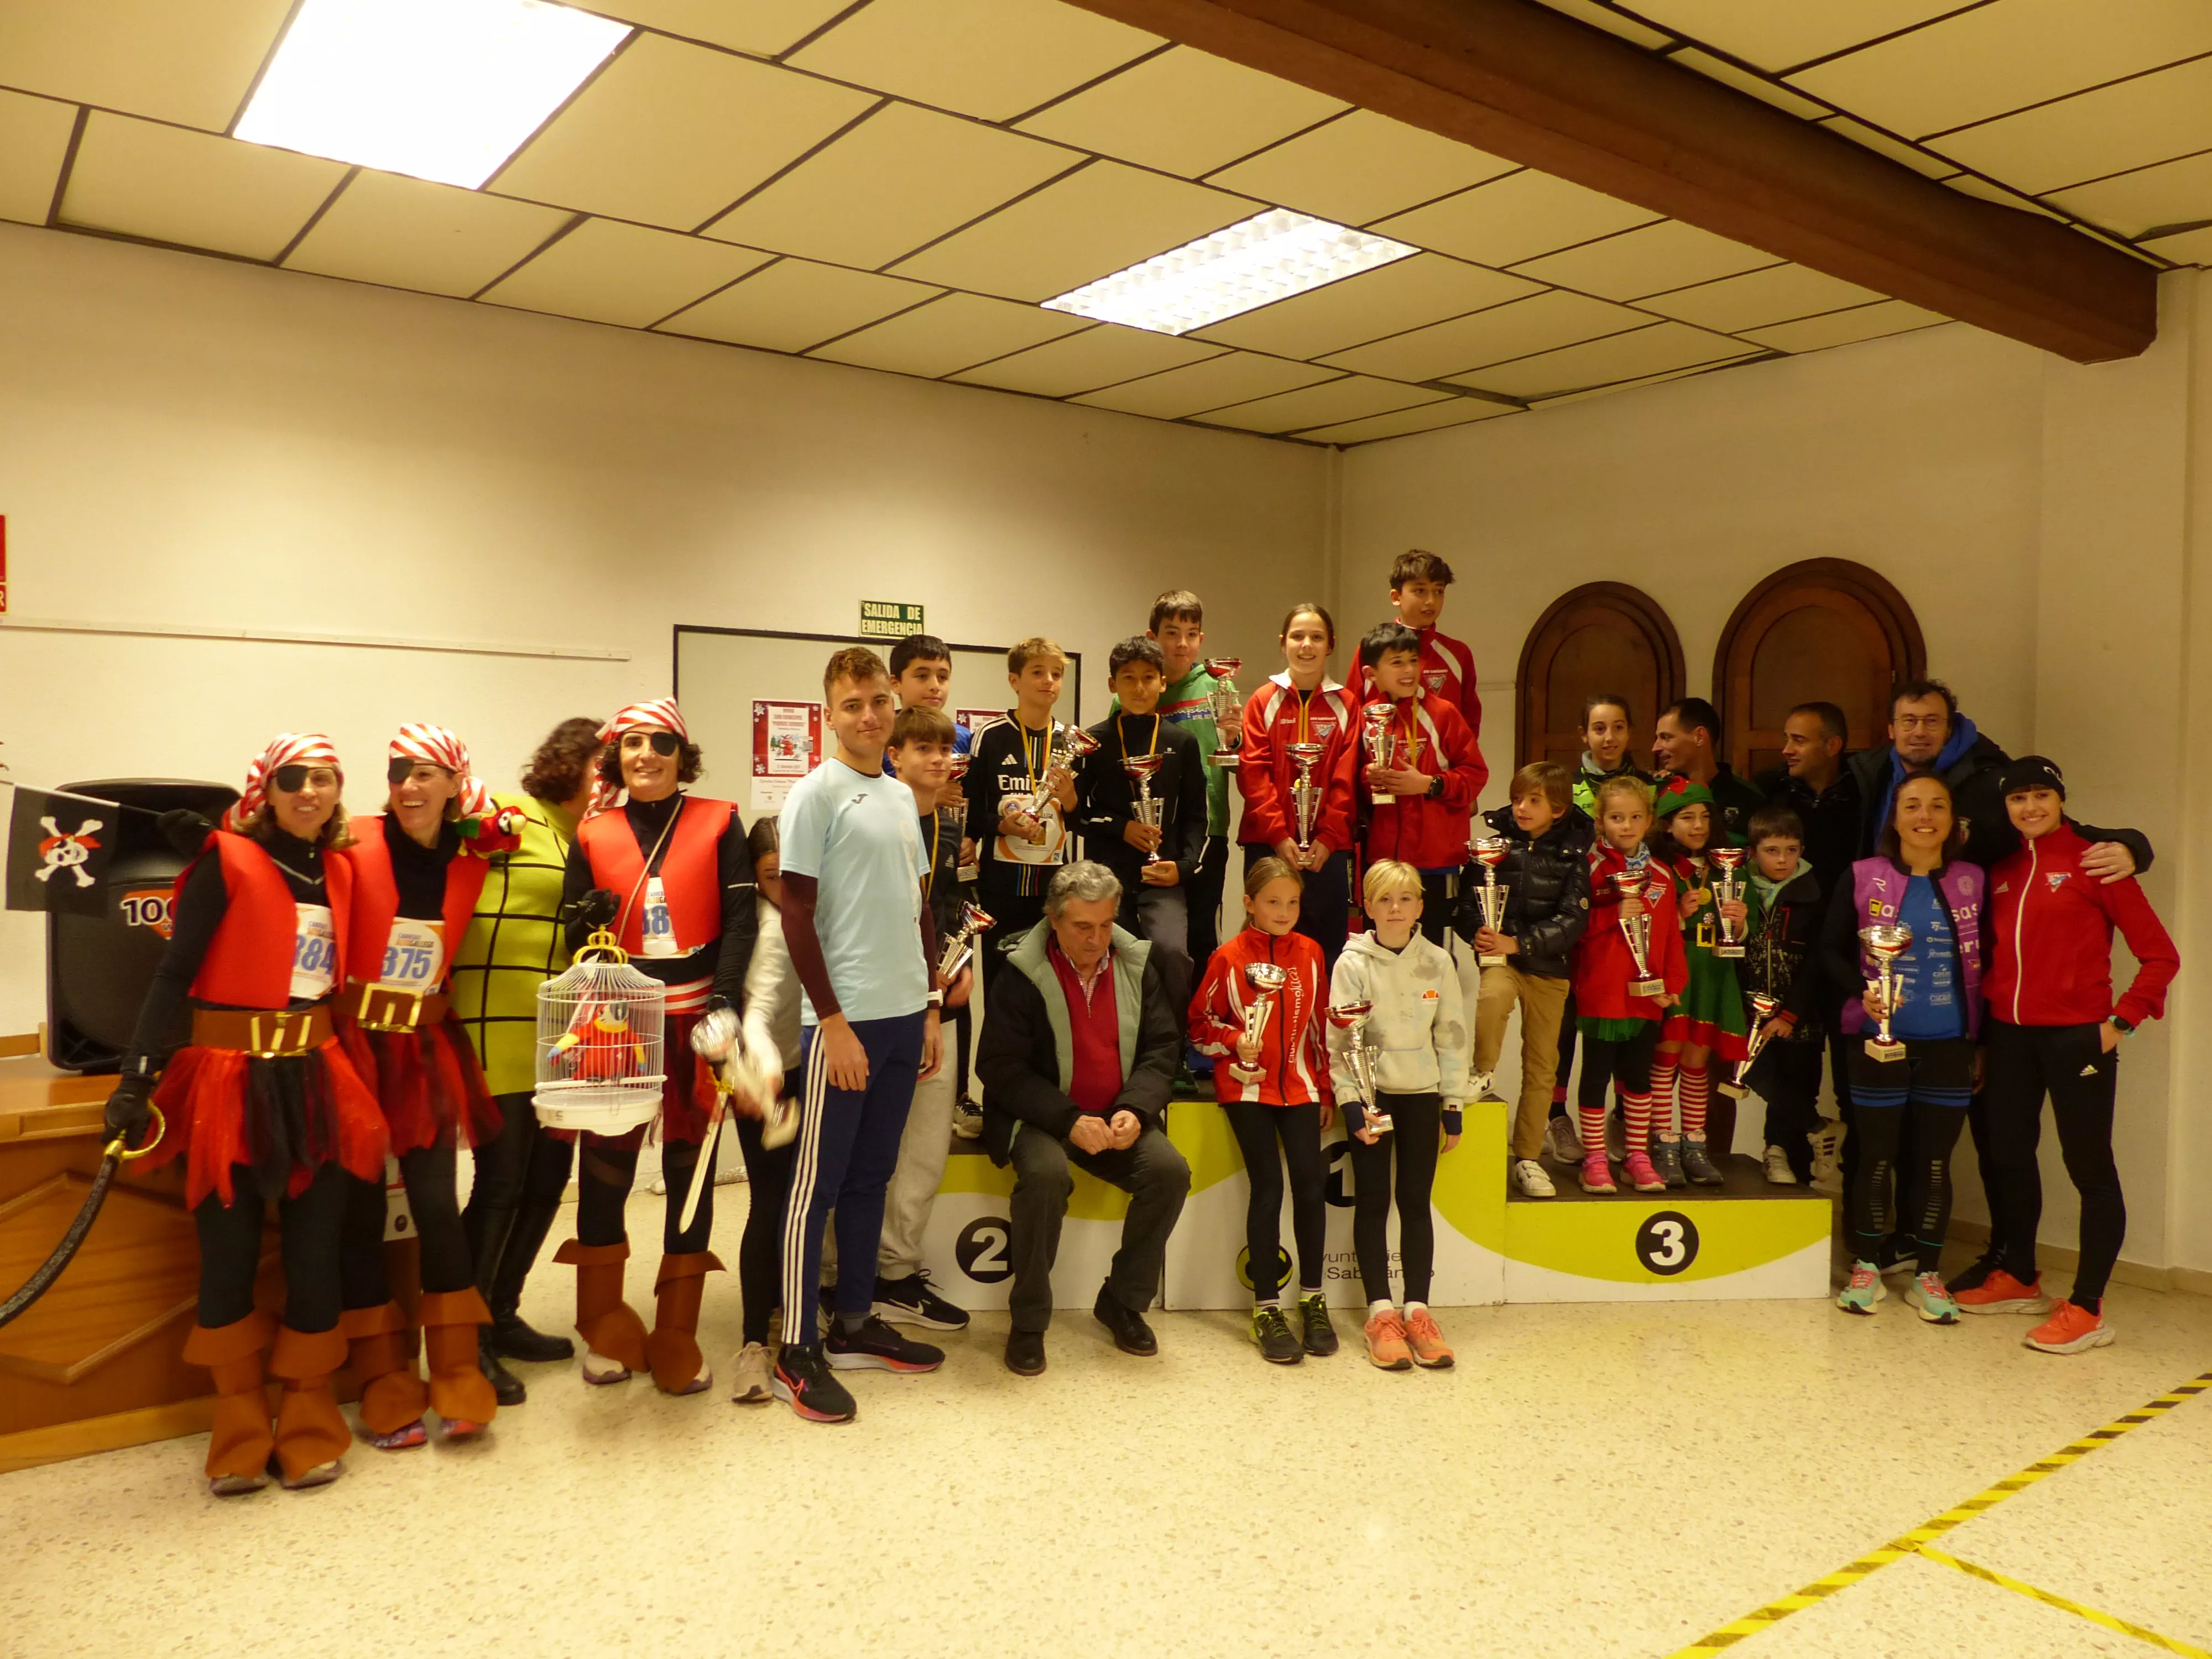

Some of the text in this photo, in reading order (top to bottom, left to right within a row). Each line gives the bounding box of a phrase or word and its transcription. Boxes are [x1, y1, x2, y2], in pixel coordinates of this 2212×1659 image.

[862, 619, 923, 636] EMERGENCIA
[864, 603, 921, 620] SALIDA DE
[1329, 1152, 1355, 1197] 1
[970, 1227, 1008, 1271] 2
[1648, 1220, 1685, 1266] 3
